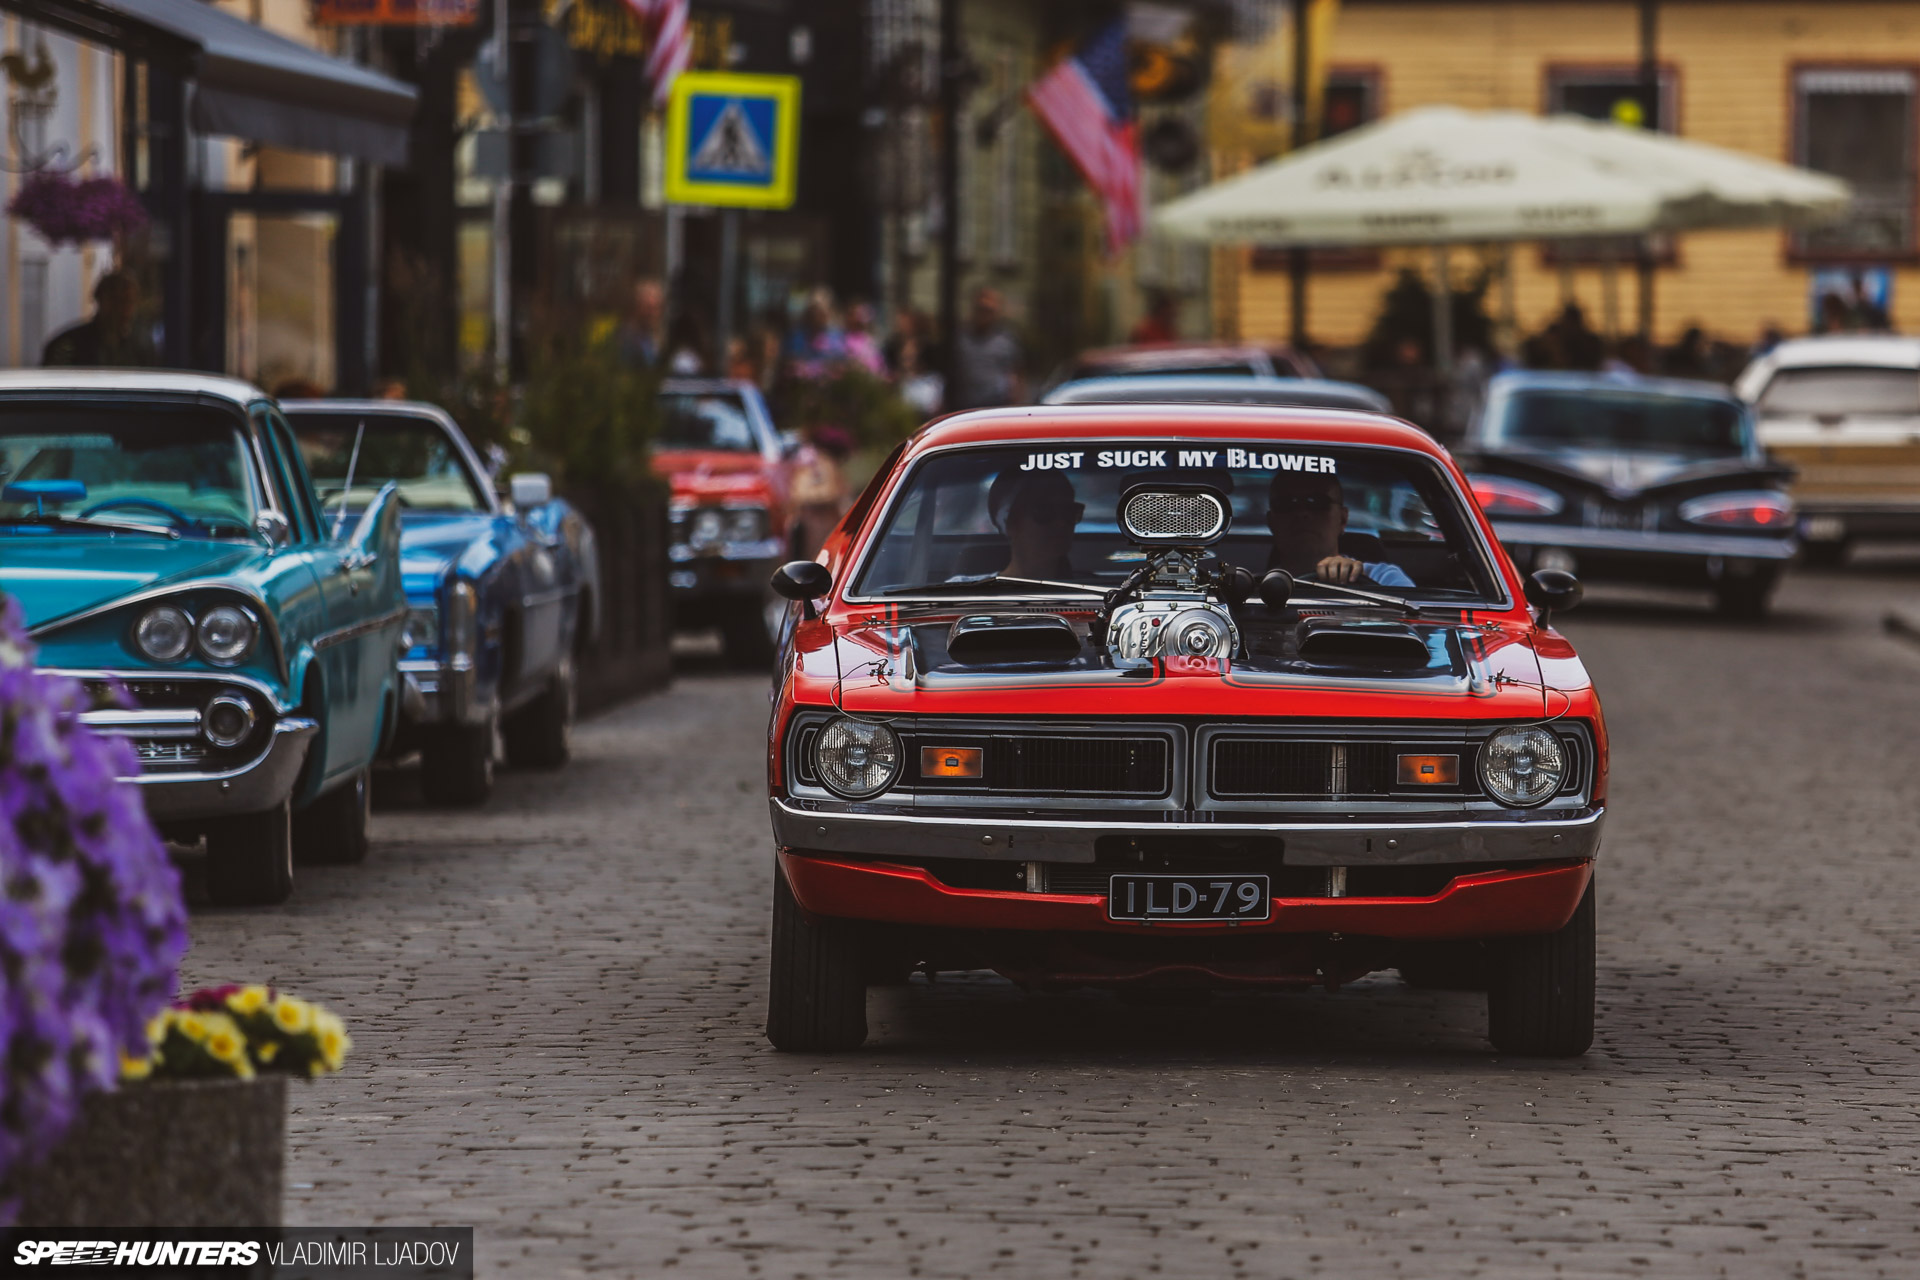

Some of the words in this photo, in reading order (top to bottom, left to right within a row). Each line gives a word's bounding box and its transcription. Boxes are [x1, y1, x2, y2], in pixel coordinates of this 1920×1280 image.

[1020, 452, 1084, 471] JUST
[1097, 450, 1166, 467] SUCK
[1178, 451, 1217, 468] MY
[1227, 448, 1336, 473] BLOWER
[1127, 881, 1260, 914] ILD-79
